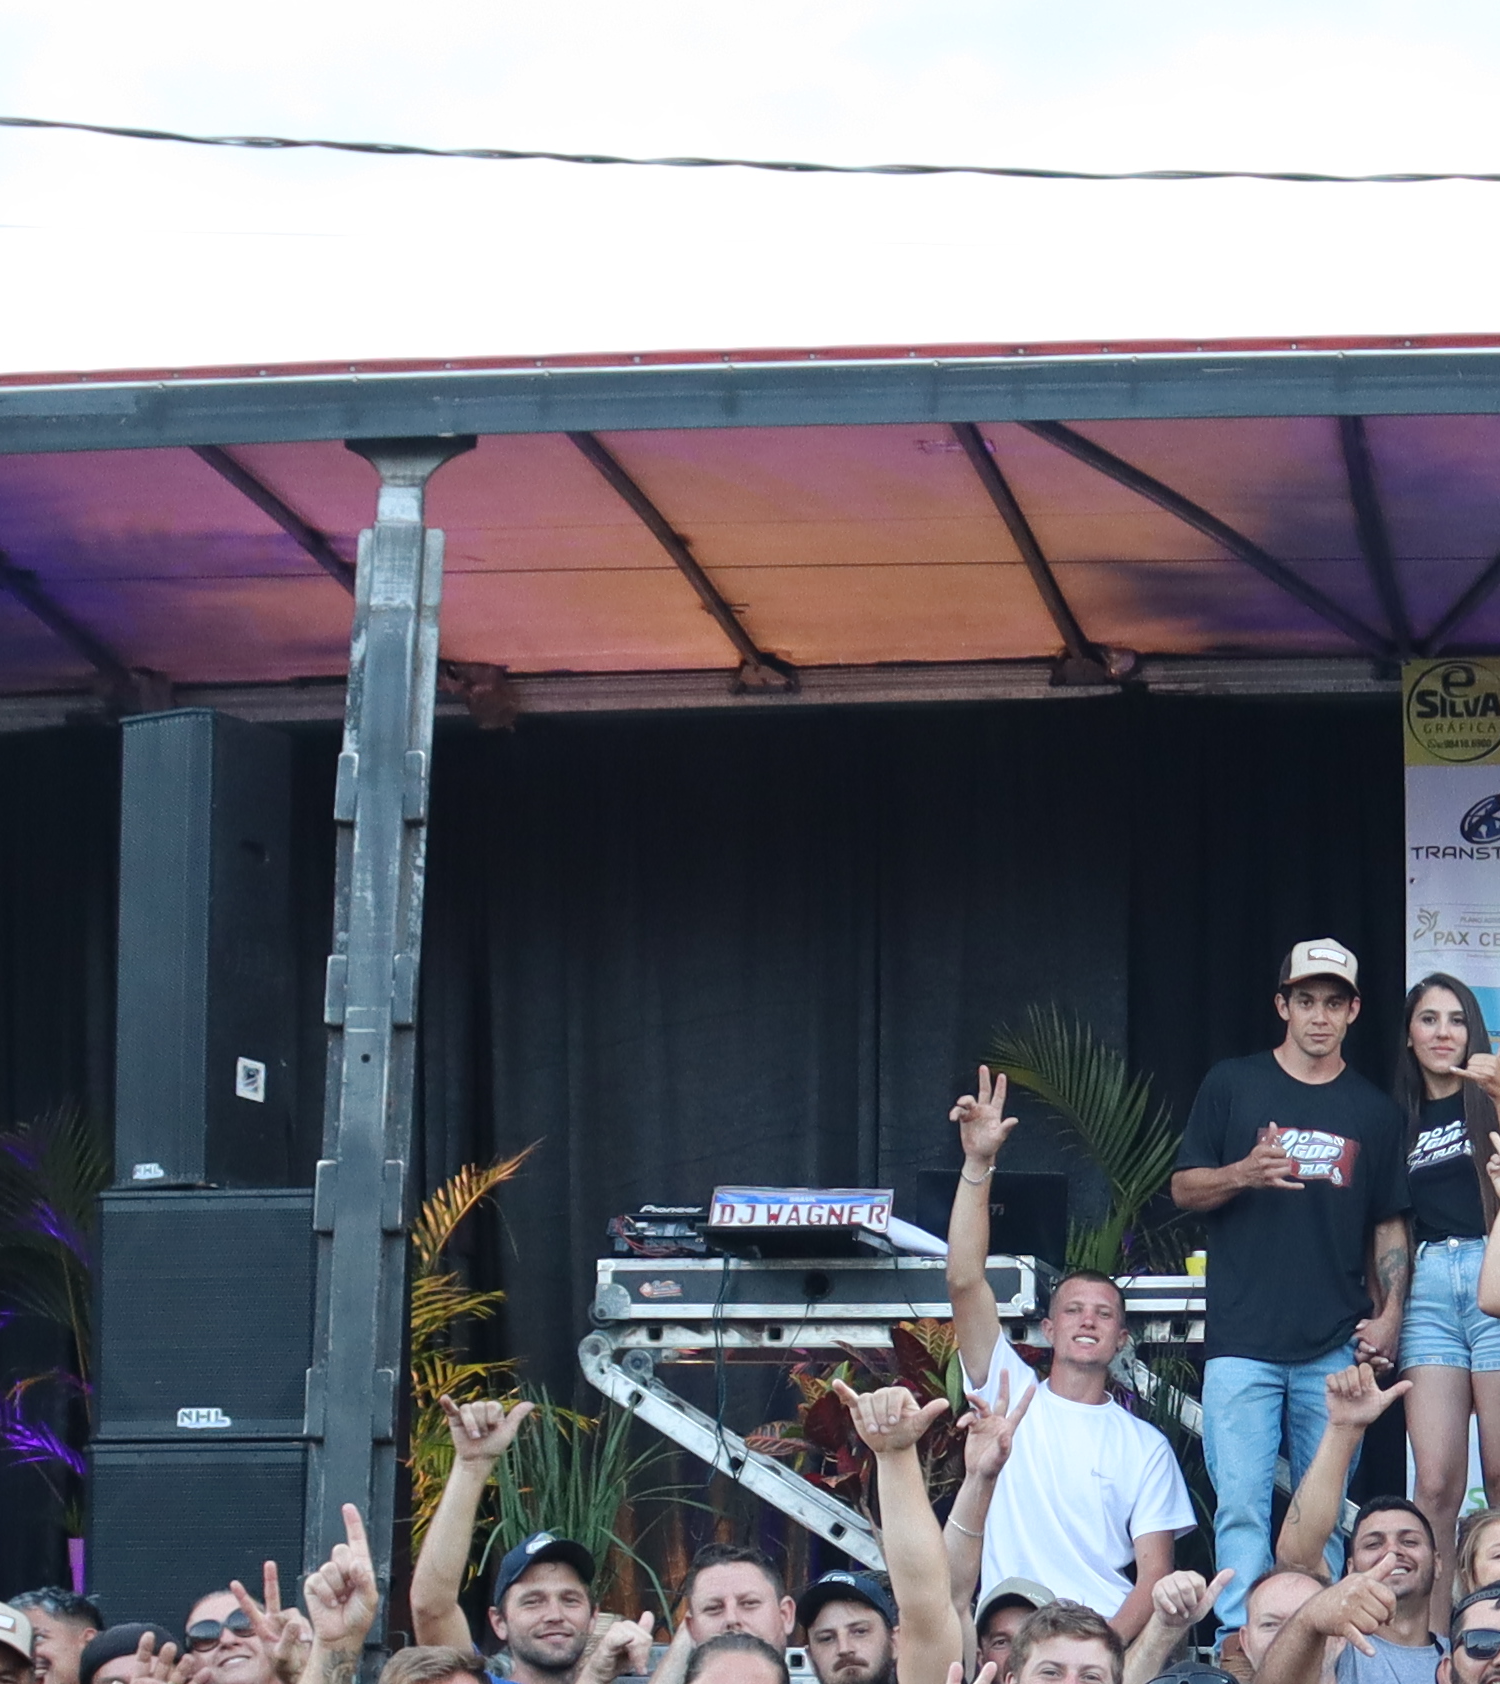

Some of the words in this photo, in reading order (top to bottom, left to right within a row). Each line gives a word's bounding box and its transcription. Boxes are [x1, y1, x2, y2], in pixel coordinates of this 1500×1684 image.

[1423, 721, 1497, 734] GRÁFICA
[1433, 931, 1470, 946] PAX
[718, 1203, 757, 1224] DJ
[766, 1203, 887, 1224] WAGNER
